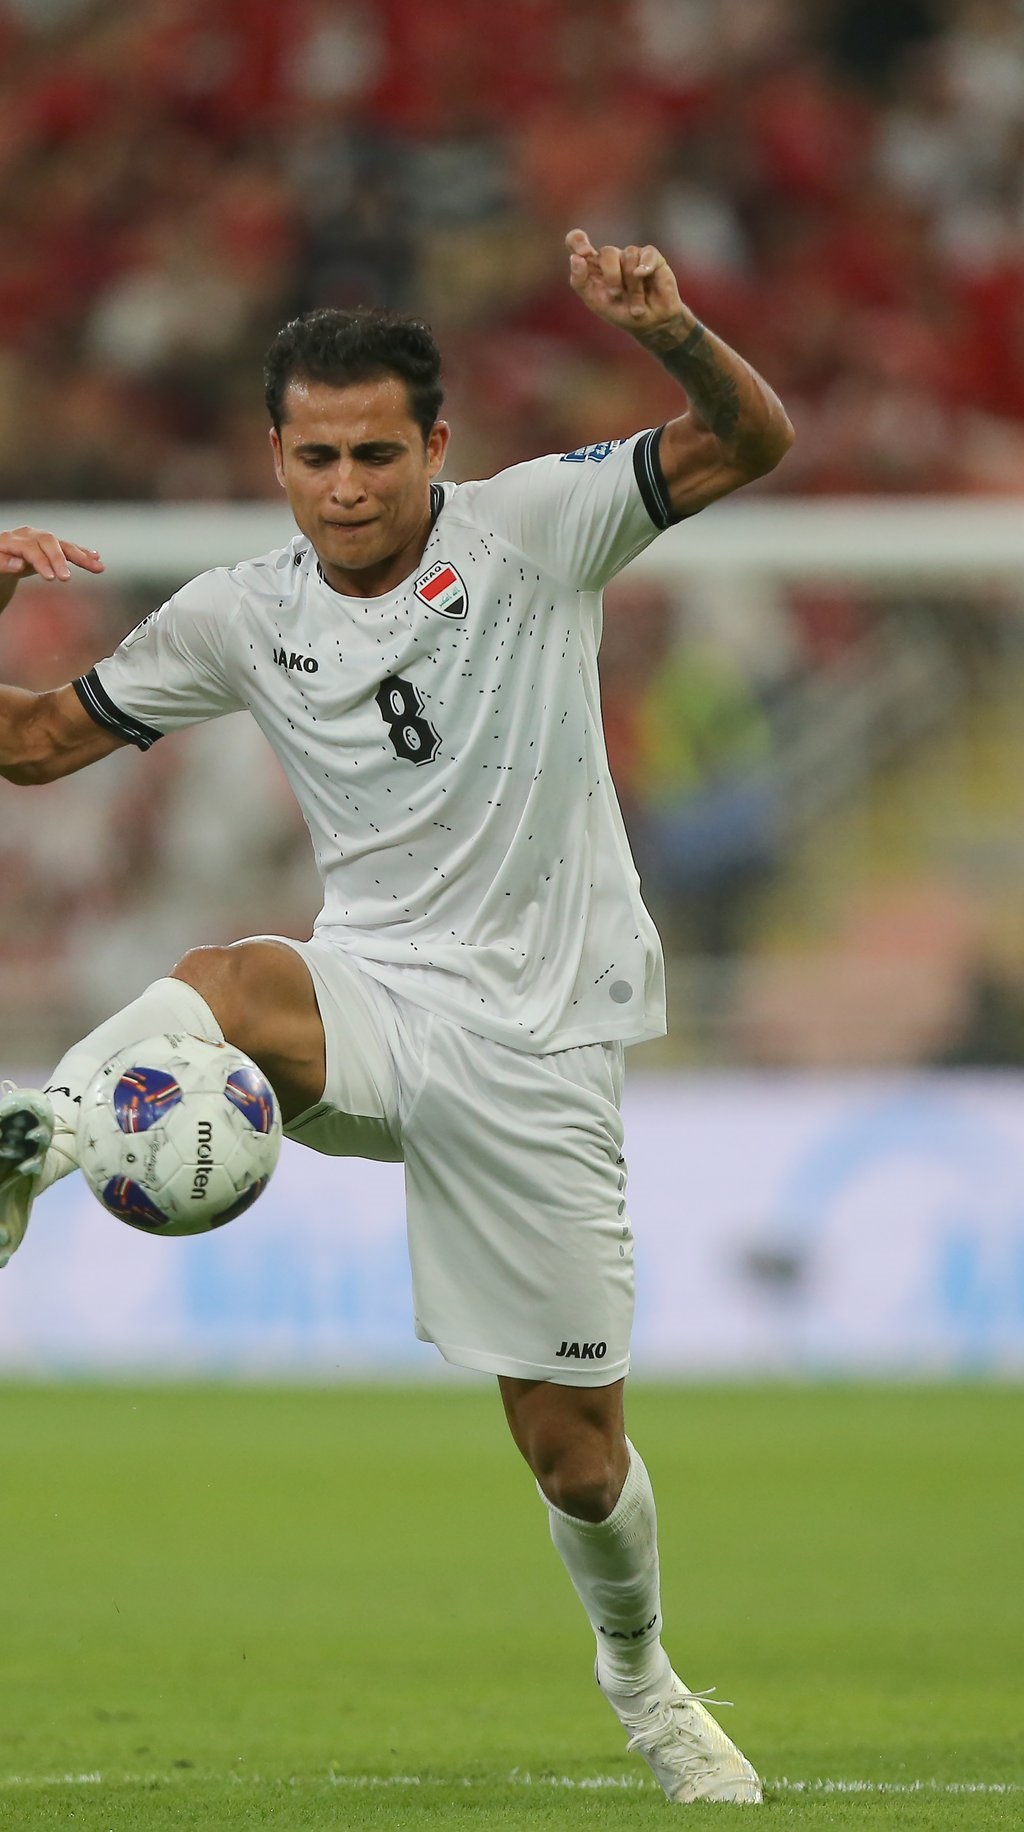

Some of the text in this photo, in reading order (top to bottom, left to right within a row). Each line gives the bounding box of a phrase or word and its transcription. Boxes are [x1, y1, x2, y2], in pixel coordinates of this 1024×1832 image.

[419, 566, 442, 586] IRAQ
[273, 648, 319, 673] JAKO
[375, 675, 443, 767] 8
[190, 1121, 214, 1200] molten
[556, 1341, 608, 1359] JAKO
[597, 1614, 657, 1640] JAKO
